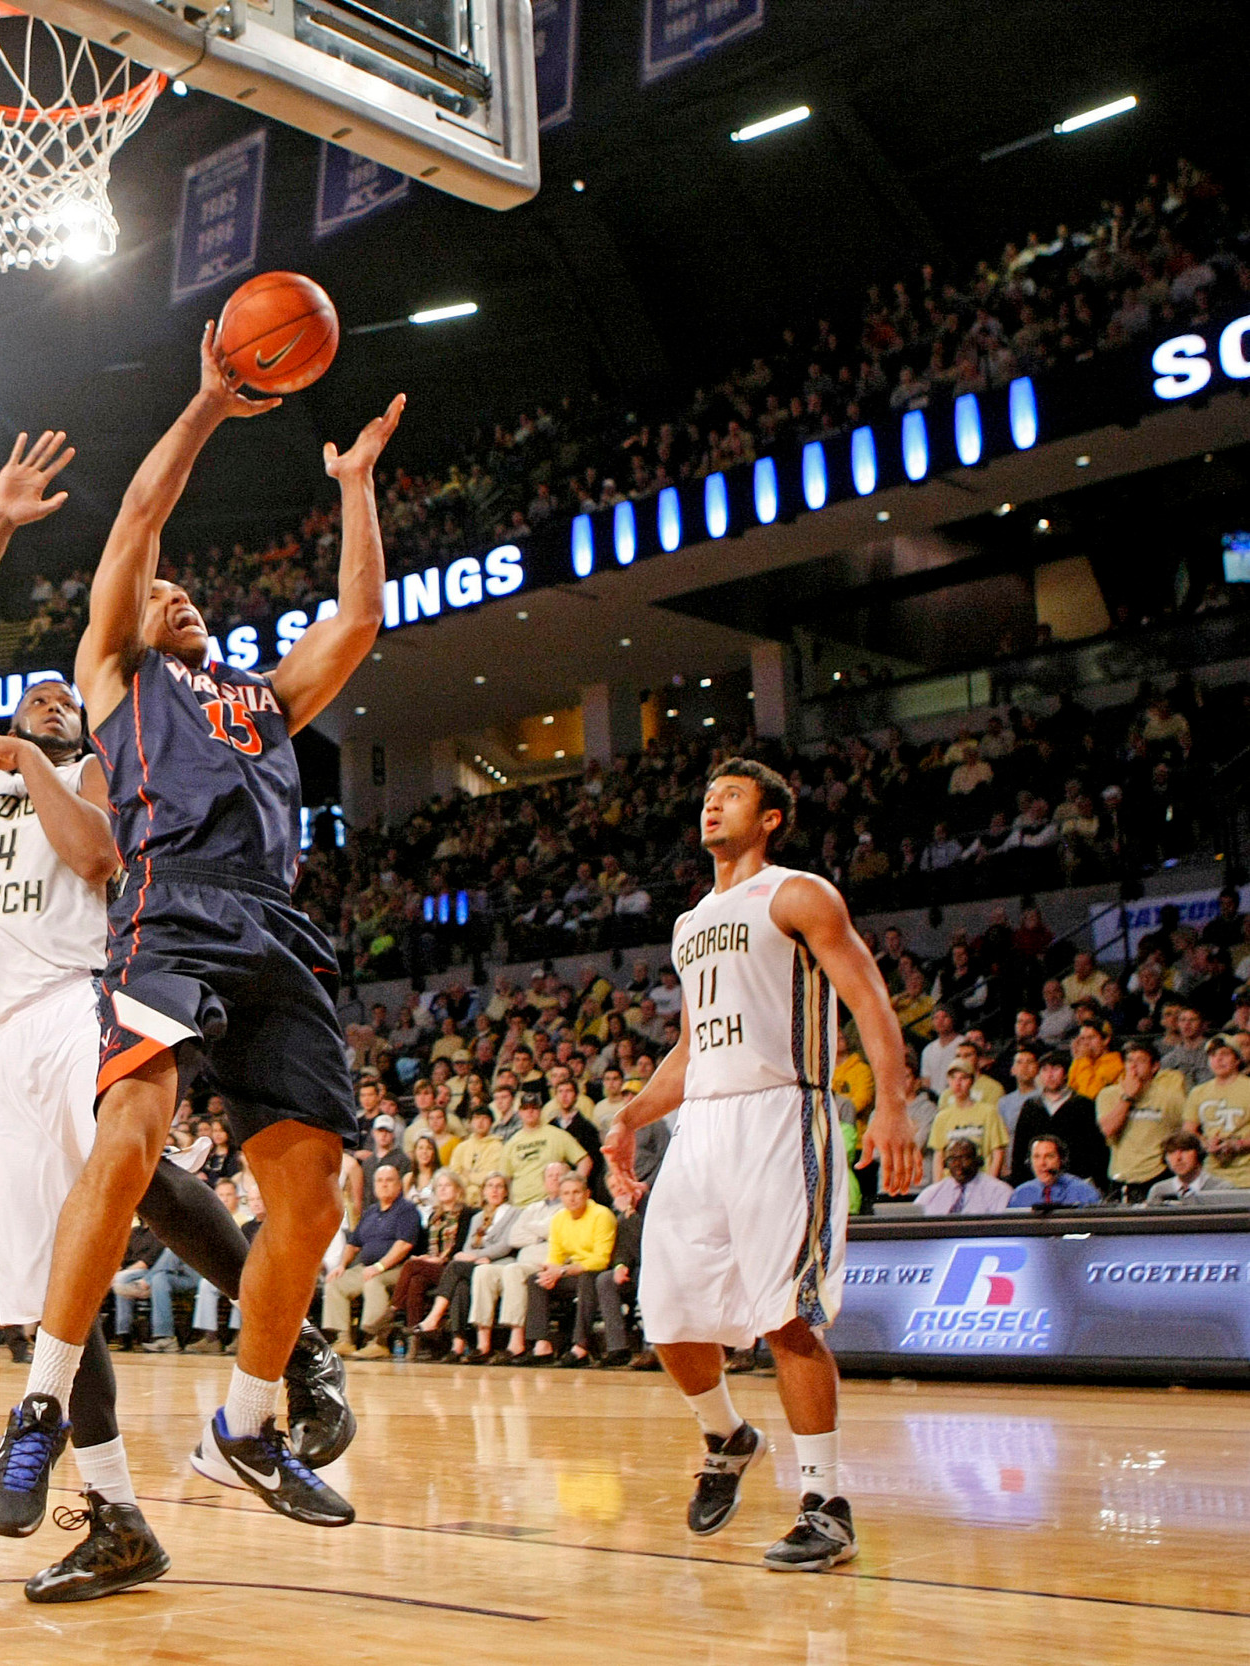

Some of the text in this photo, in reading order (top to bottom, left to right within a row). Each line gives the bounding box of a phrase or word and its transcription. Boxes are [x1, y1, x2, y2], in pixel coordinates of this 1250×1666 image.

[200, 698, 263, 756] 15
[677, 922, 749, 973] GEORGIA
[698, 964, 718, 1010] 11
[897, 1263, 934, 1285] WE
[1086, 1260, 1240, 1285] TOGETHER
[905, 1306, 1052, 1333] RUSSELL
[899, 1331, 1049, 1350] ATHLETIC
